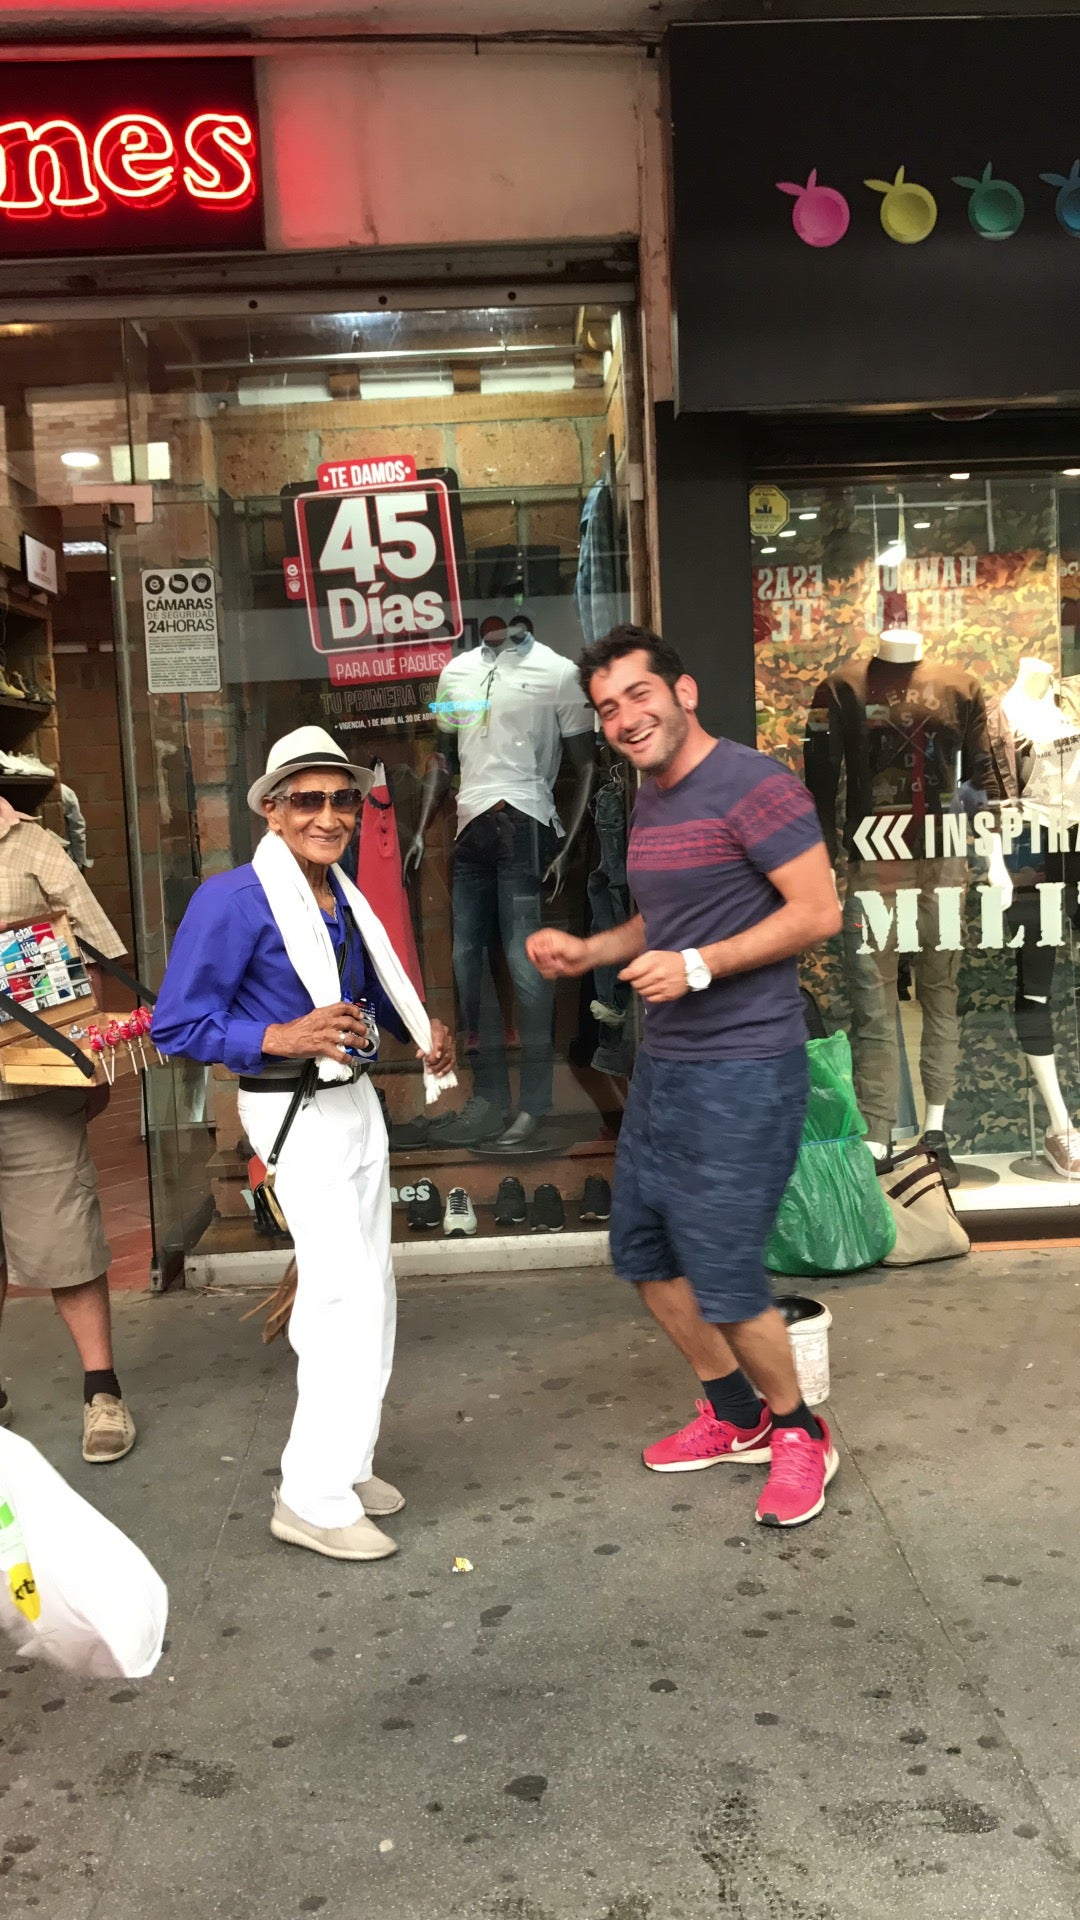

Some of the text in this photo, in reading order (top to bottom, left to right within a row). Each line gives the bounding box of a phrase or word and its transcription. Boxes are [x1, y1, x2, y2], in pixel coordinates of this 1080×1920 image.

[328, 461, 406, 489] TE DAMOS
[319, 491, 437, 583] 45
[146, 597, 213, 612] CÁMARAS
[147, 610, 214, 620] DE SEGURIDAD
[326, 581, 445, 640] Días
[335, 653, 446, 680] PARA QUE PAGUES
[320, 691, 342, 715] TU
[344, 685, 417, 712] PRIMERA
[372, 718, 380, 727] DE
[381, 716, 396, 726] ABRIL
[397, 715, 405, 724] AL
[405, 714, 413, 723] 30
[414, 713, 421, 722] DE
[924, 807, 1080, 859] INSPIR
[854, 882, 1080, 955] MILI
[15, 925, 33, 942] star
[20, 941, 40, 960] lite
